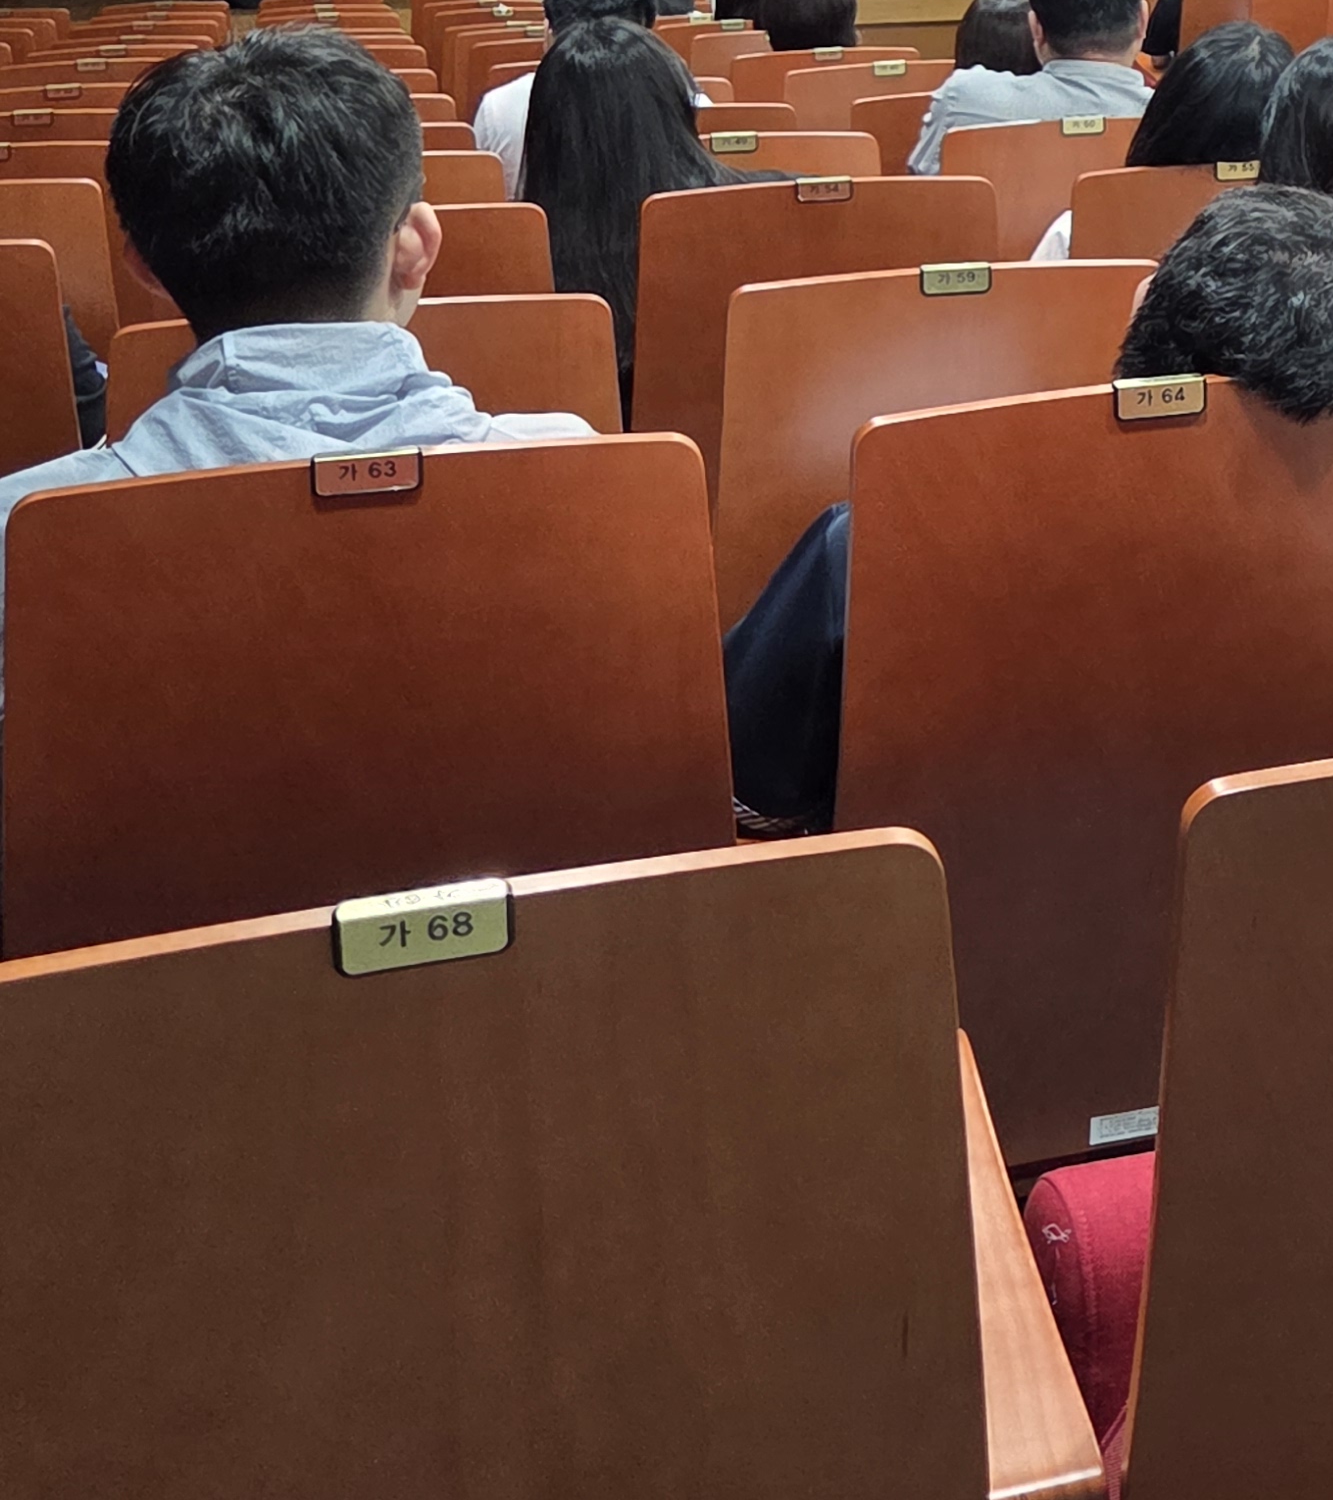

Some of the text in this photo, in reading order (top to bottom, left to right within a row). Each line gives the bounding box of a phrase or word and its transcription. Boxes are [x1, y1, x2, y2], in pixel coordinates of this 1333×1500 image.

[937, 271, 976, 286] 가 59
[1136, 386, 1186, 407] 가 64
[338, 460, 397, 481] 가 63
[378, 911, 474, 948] 가 68
